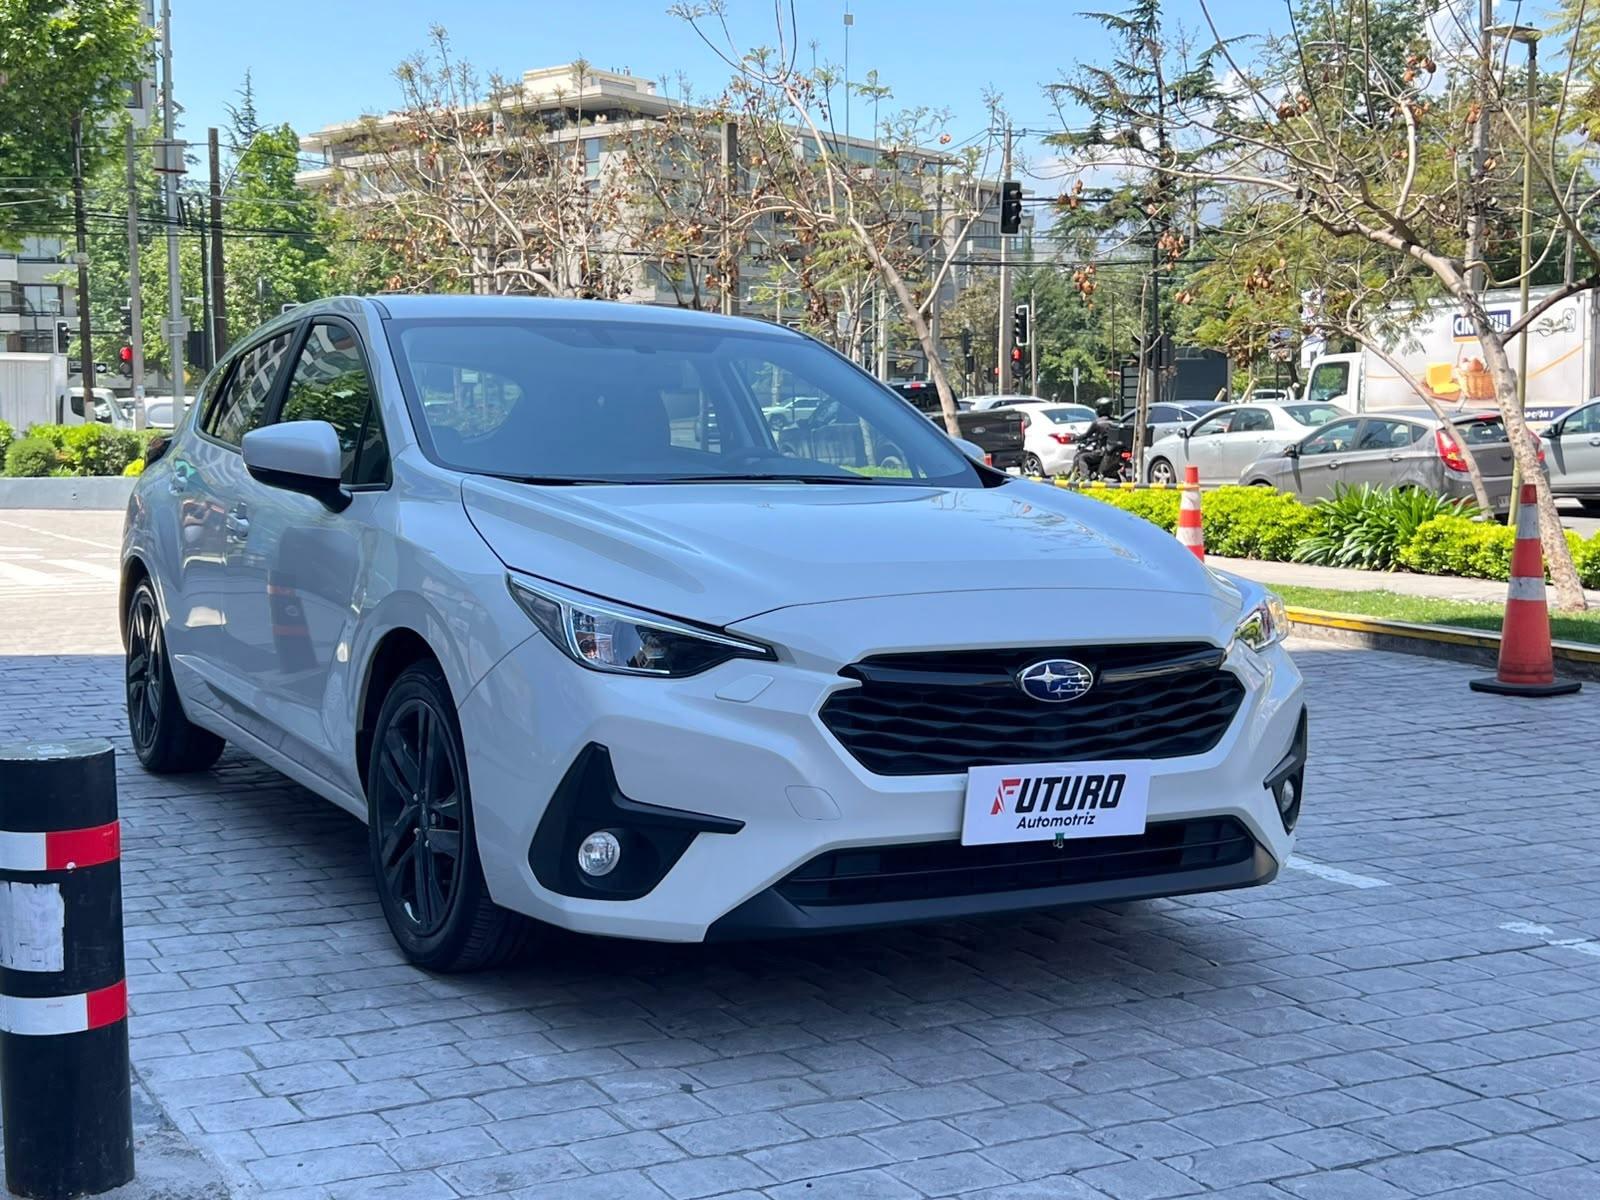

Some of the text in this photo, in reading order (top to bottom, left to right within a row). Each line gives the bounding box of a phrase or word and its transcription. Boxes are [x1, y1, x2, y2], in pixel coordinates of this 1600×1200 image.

[1454, 313, 1510, 336] CINUL
[990, 774, 1127, 816] FUTURO
[1016, 811, 1096, 830] Automotriz
